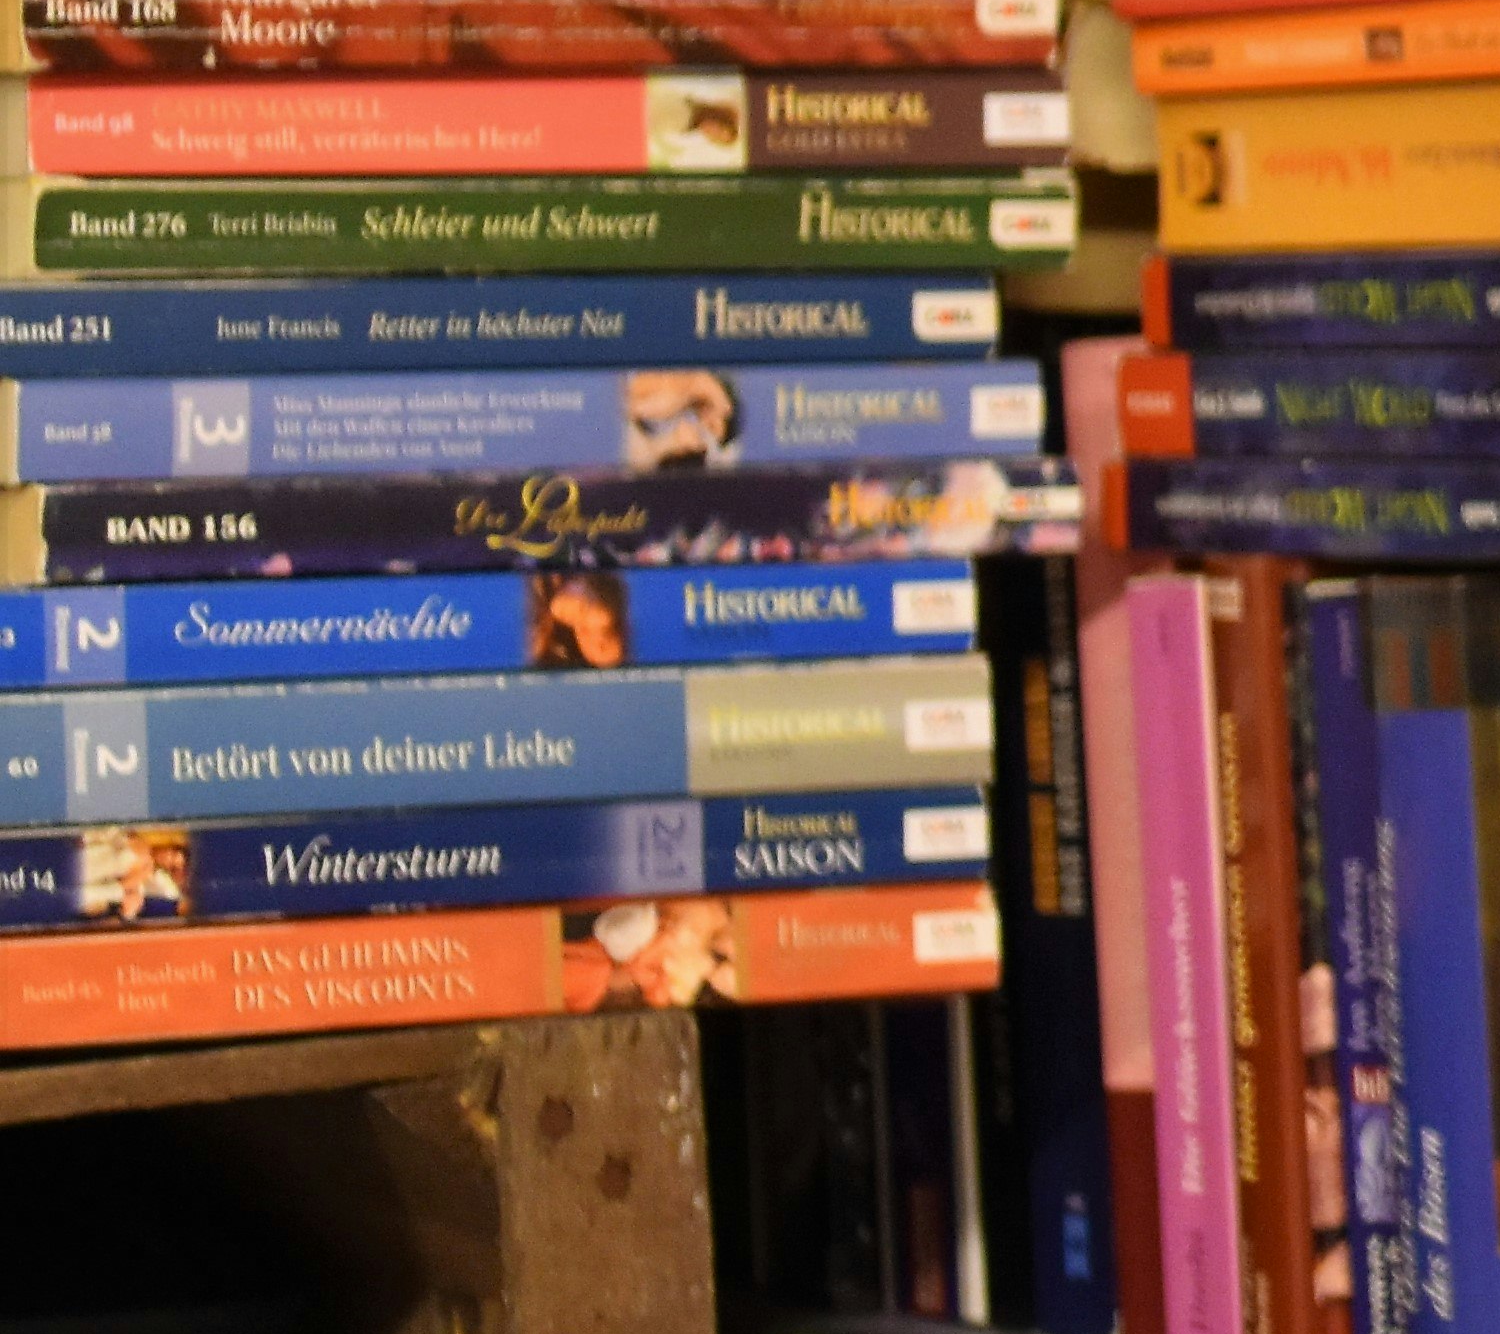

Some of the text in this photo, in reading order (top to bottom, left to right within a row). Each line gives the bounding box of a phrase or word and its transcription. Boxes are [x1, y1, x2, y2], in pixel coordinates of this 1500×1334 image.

[220, 12, 335, 46] Moore
[766, 84, 929, 127] HISTORICAL
[69, 190, 974, 244] Band 276 Schleier und Schwert HISTORICAL
[581, 288, 869, 338] Not HISTORICAL
[107, 515, 190, 543] BAND
[175, 582, 865, 645] Sommernächte HISTORICAL
[172, 730, 575, 782] Betört von deiner Liebe
[263, 834, 502, 886] Wintersturm
[734, 839, 864, 879] SAISON
